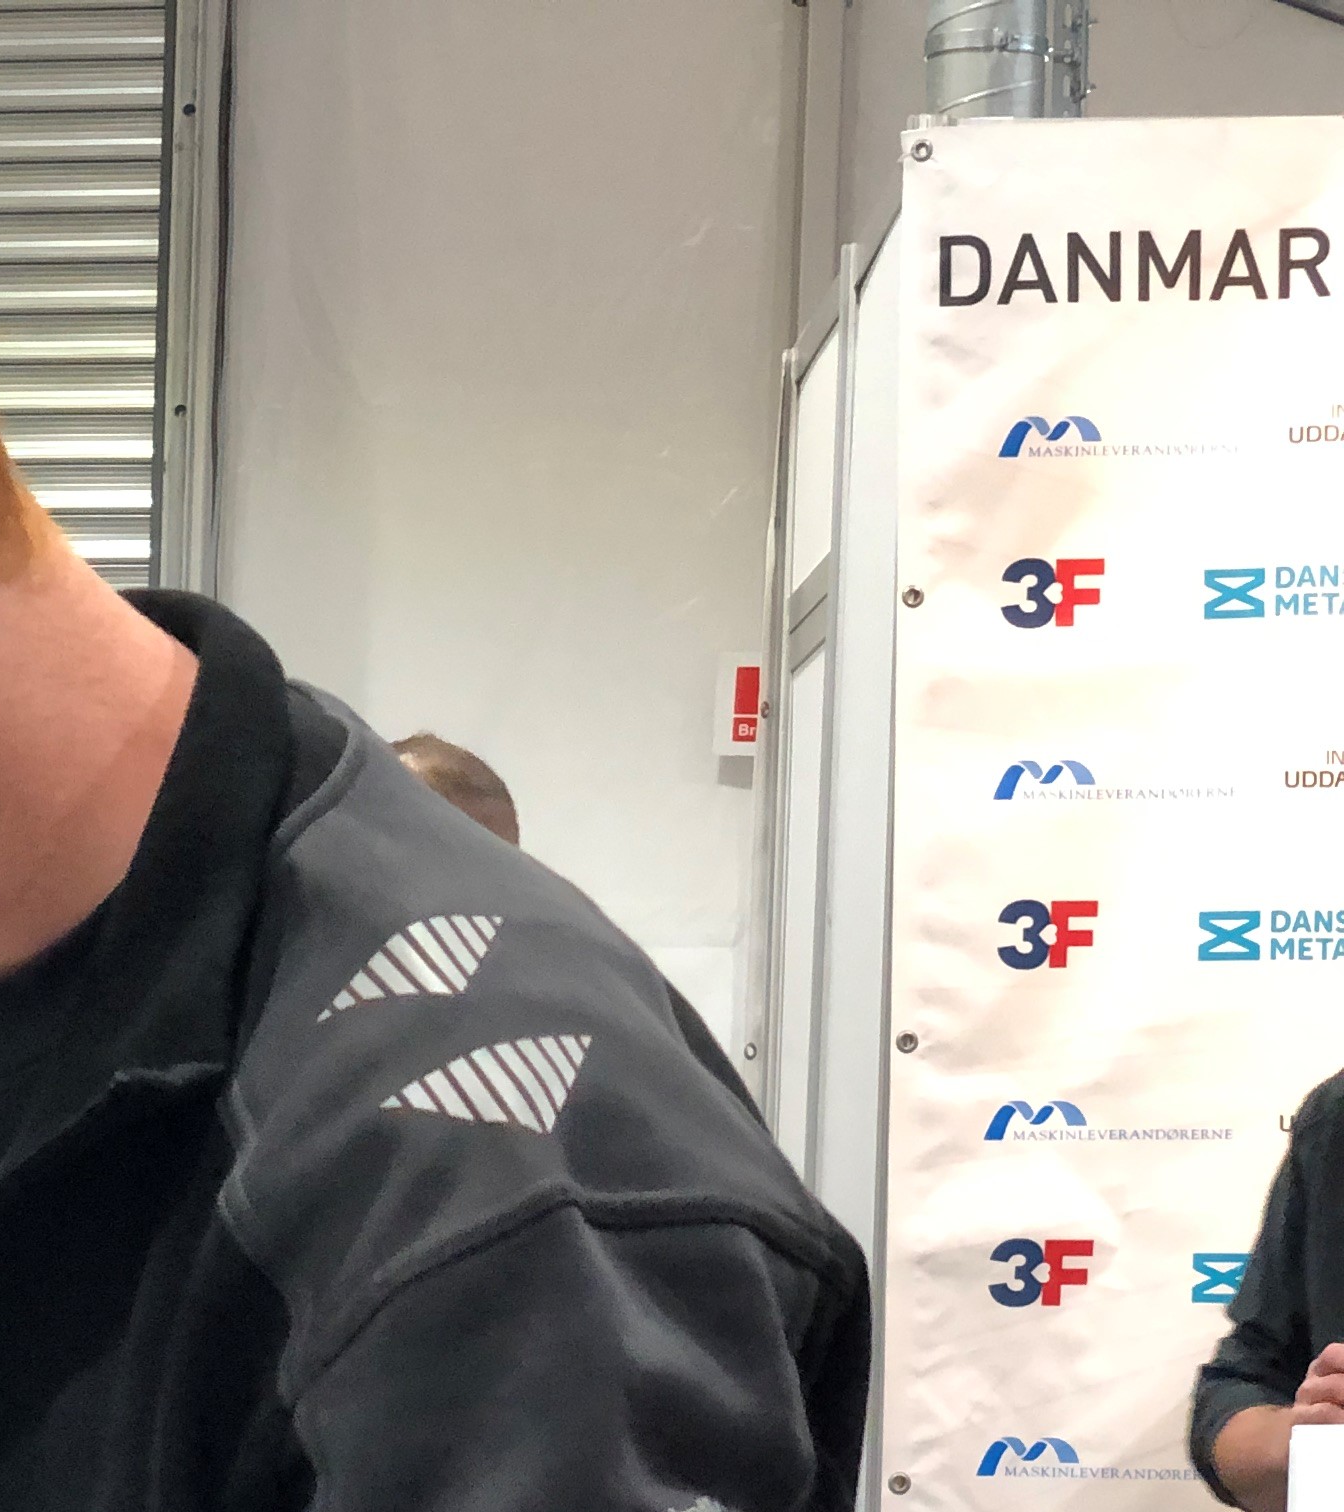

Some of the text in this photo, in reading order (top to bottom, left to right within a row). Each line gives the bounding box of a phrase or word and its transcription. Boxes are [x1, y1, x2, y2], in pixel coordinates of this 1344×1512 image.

[939, 227, 1331, 307] DANMAR
[1288, 425, 1344, 443] UDD
[1000, 558, 1105, 629] 3F
[1275, 565, 1344, 588] DAN
[997, 900, 1098, 970] 3F
[1013, 1128, 1233, 1142] MASKINLEVERANDØRERNE
[988, 1238, 1094, 1307] 3F
